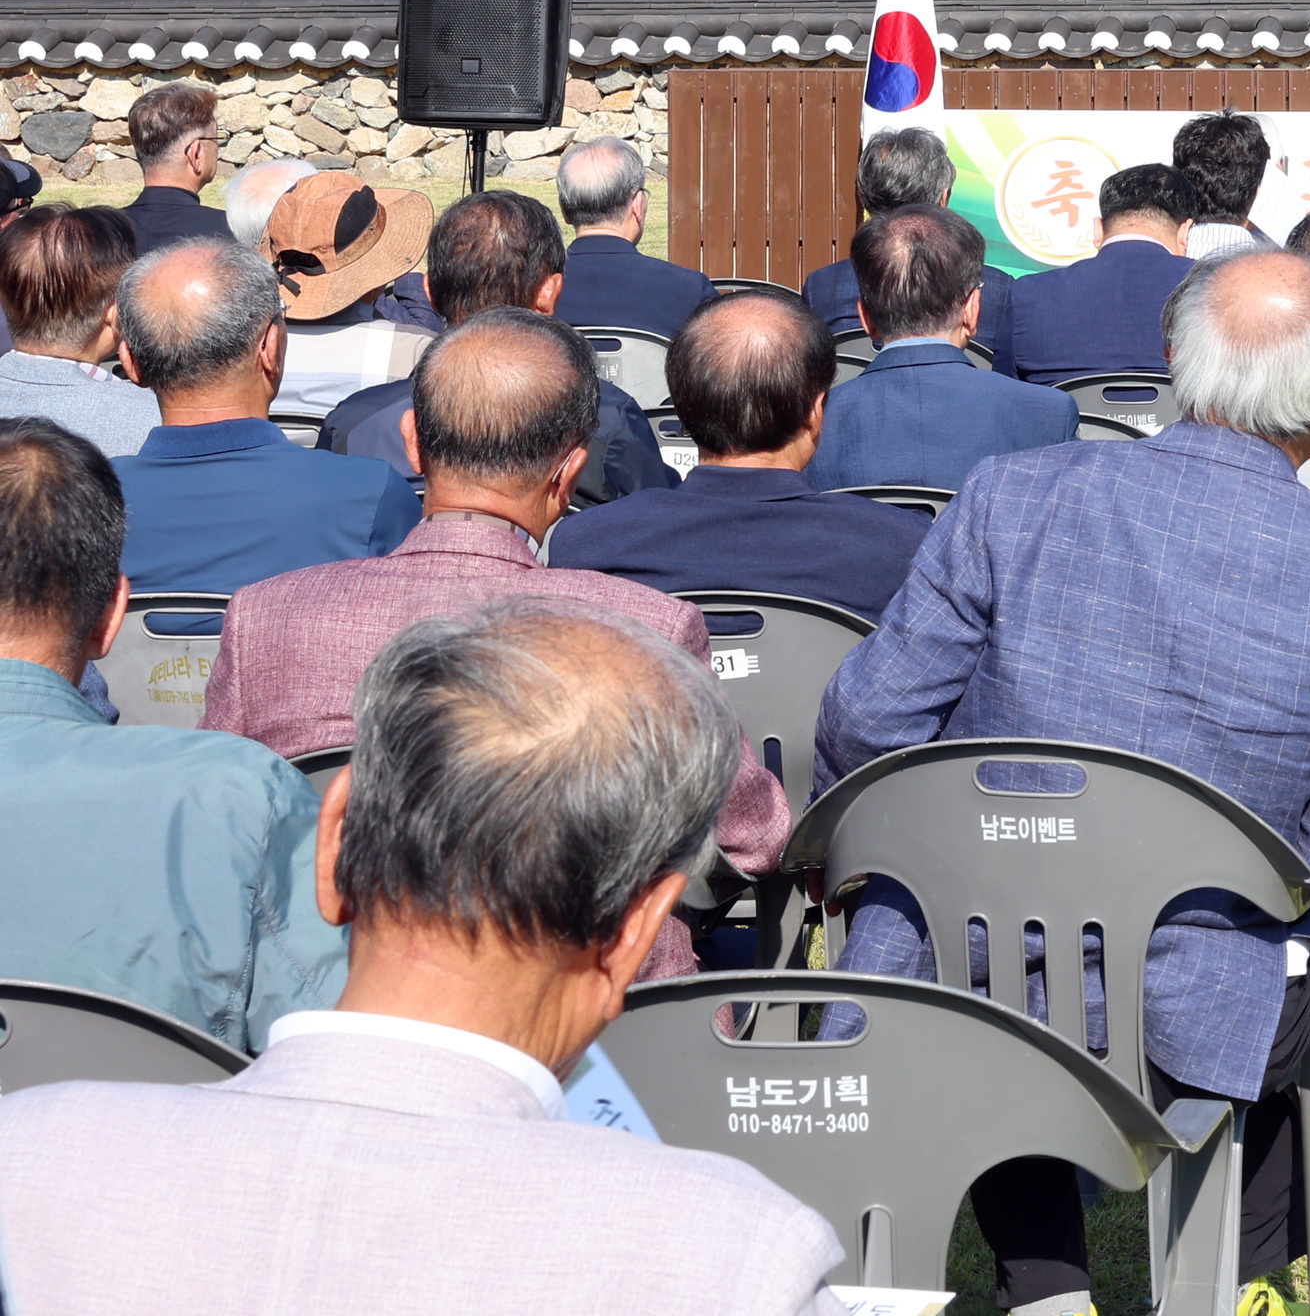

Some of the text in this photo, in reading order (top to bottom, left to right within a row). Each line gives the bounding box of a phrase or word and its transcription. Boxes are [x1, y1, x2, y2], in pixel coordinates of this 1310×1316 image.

[1030, 159, 1096, 228] 축
[980, 813, 1078, 844] 남도이벤트
[725, 1074, 870, 1109] 남도기획
[727, 1111, 871, 1135] 010-8471-3400
